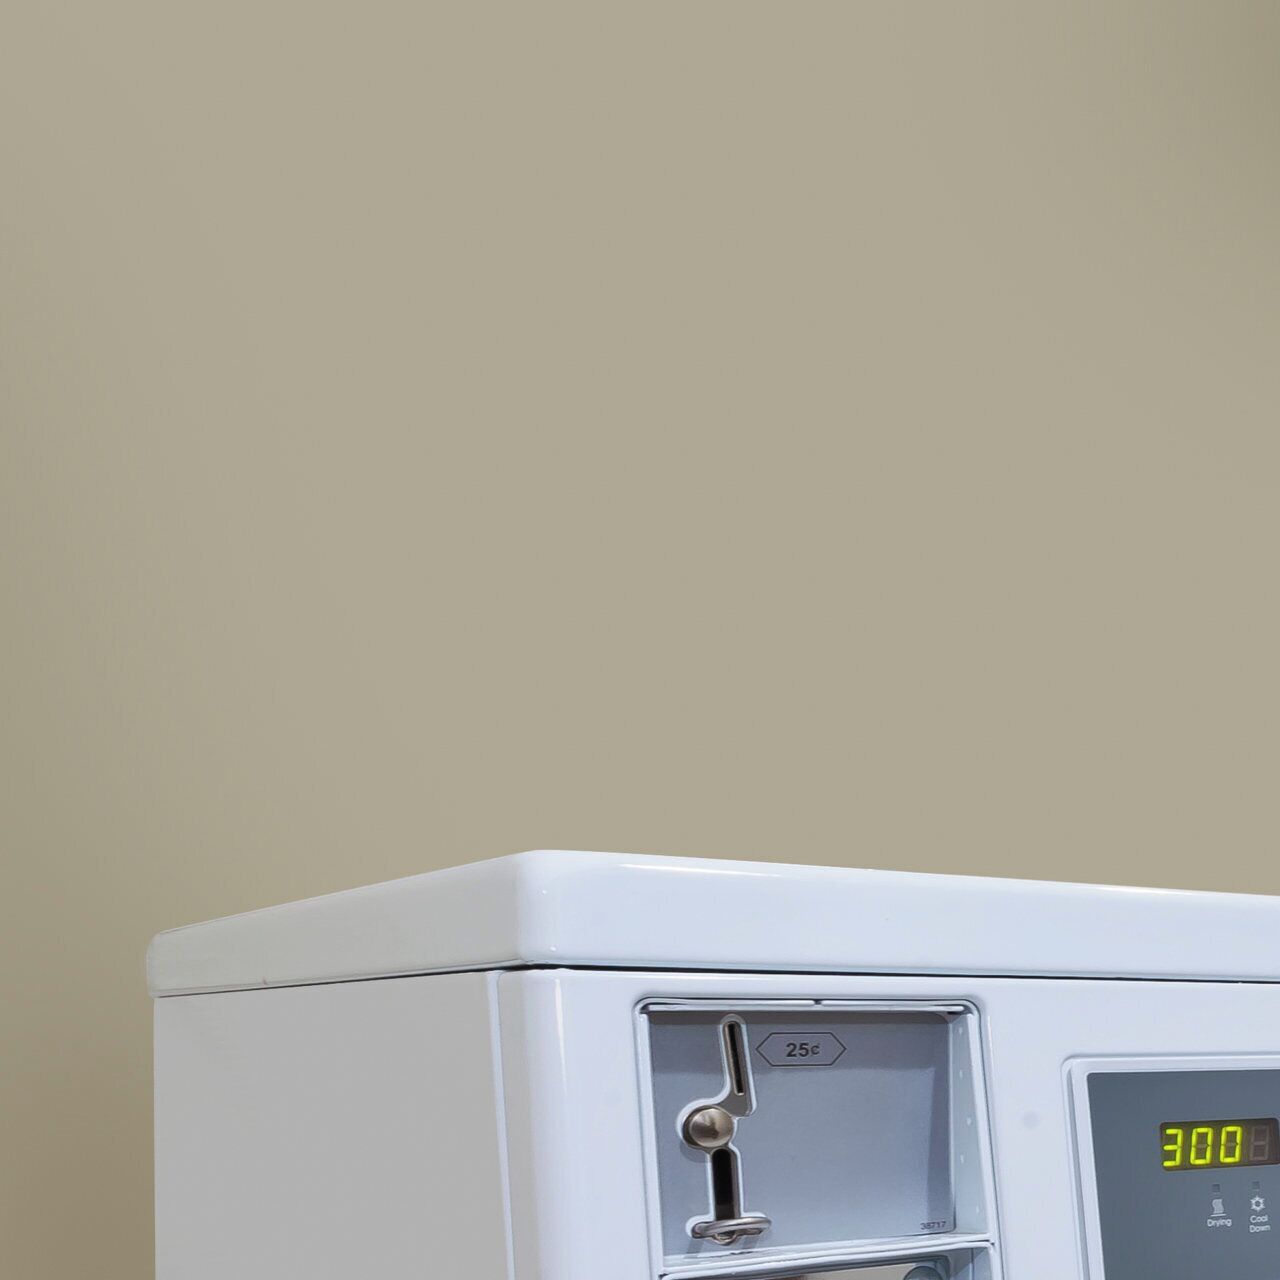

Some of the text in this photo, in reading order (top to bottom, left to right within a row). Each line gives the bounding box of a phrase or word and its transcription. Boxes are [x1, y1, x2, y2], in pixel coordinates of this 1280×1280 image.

[1163, 1126, 1242, 1167] 300
[1207, 1219, 1232, 1227] Drying
[1250, 1215, 1268, 1223] Cool
[1249, 1225, 1271, 1233] Down
